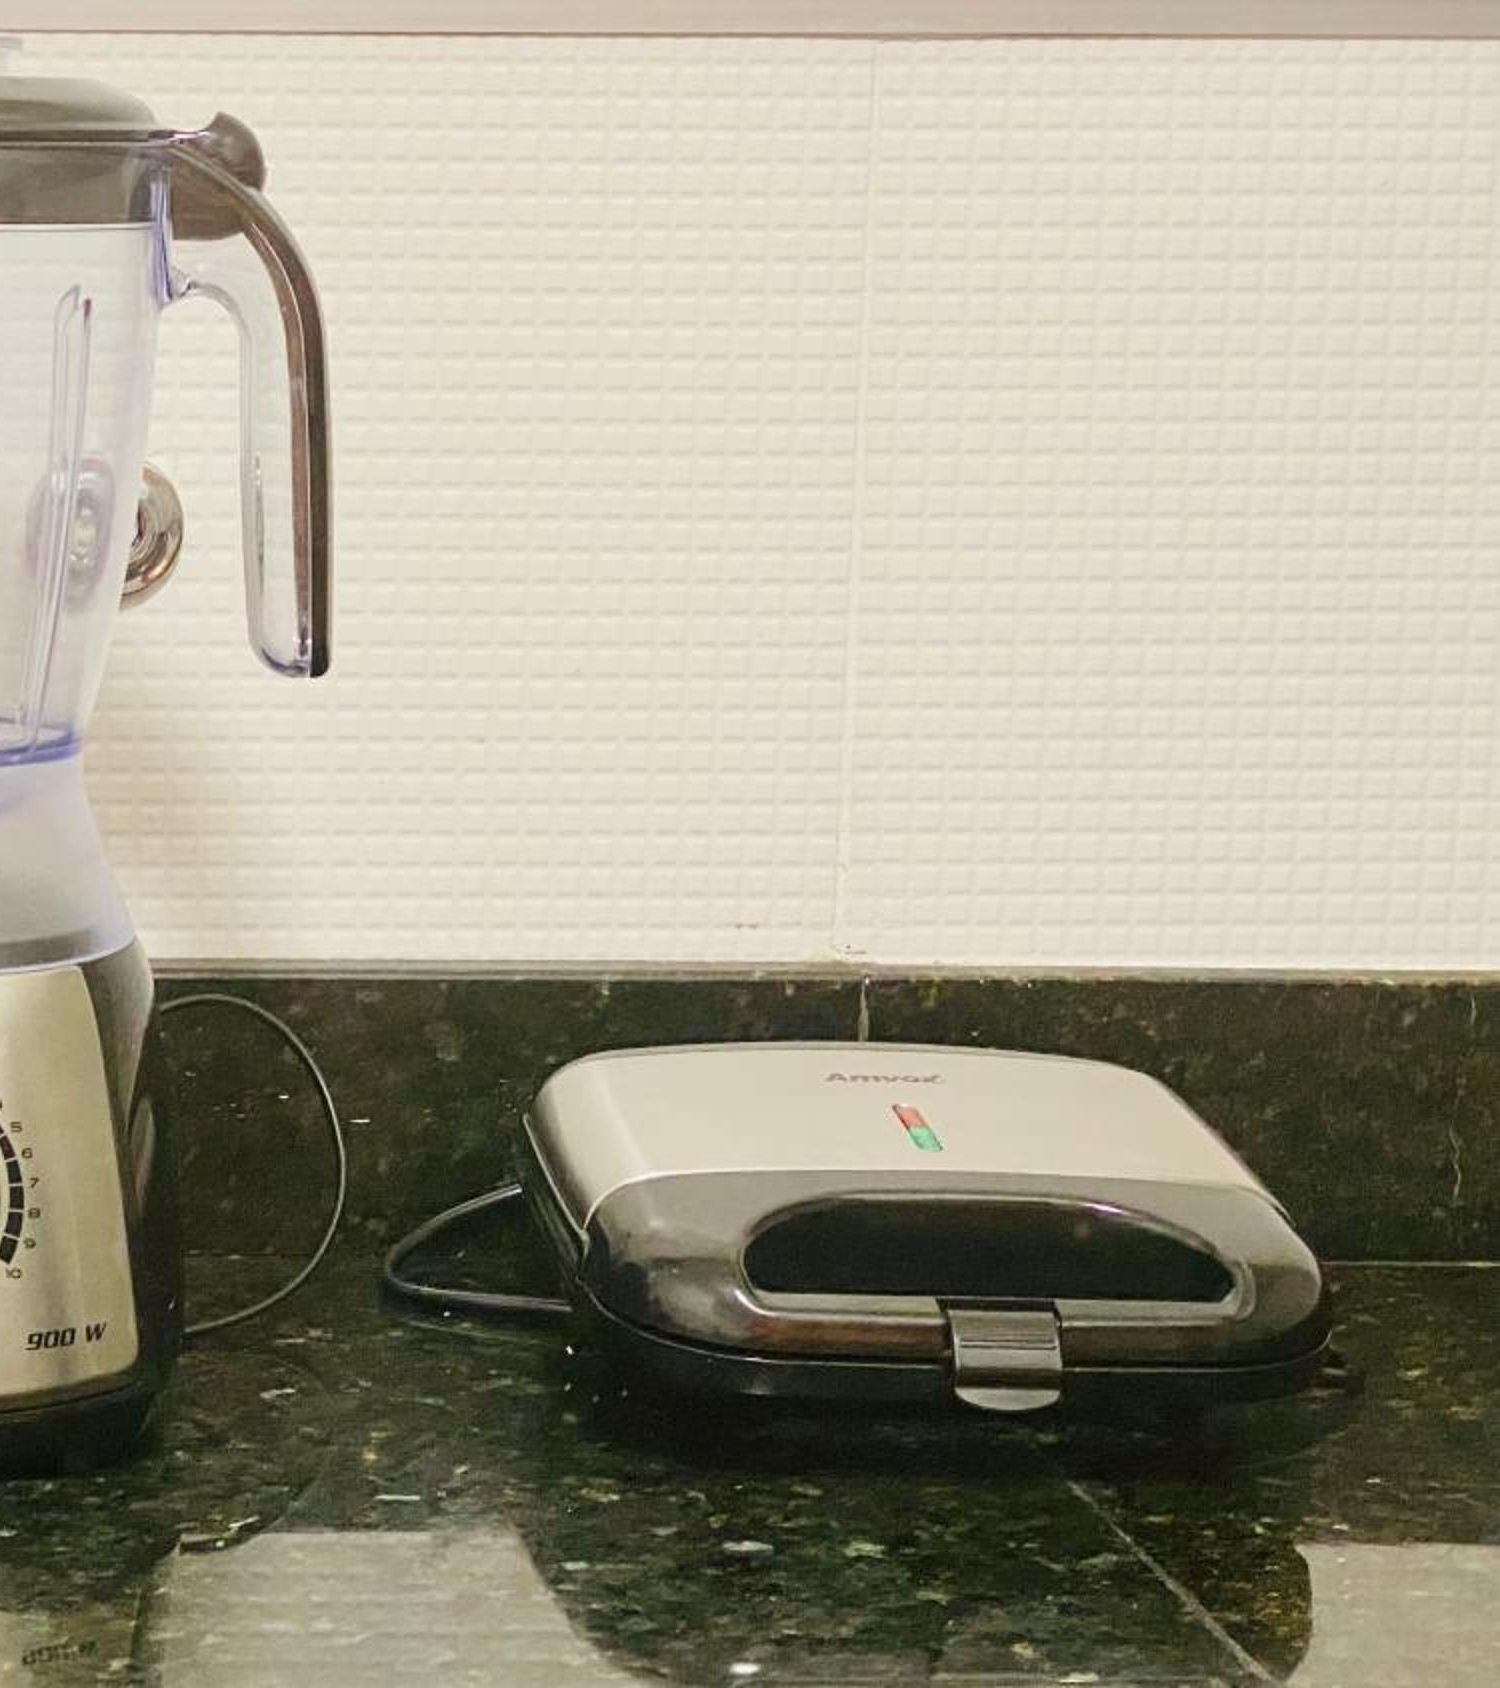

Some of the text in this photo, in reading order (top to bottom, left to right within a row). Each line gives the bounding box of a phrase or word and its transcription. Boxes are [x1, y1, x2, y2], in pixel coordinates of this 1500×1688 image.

[825, 1073, 945, 1085] Amvox
[10, 1121, 22, 1133] 5
[22, 1147, 34, 1159] 6
[29, 1177, 40, 1188] 7
[28, 1207, 40, 1219] 8
[23, 1238, 37, 1249] 9
[5, 1267, 23, 1279] 10
[24, 1321, 107, 1351] 900 W
